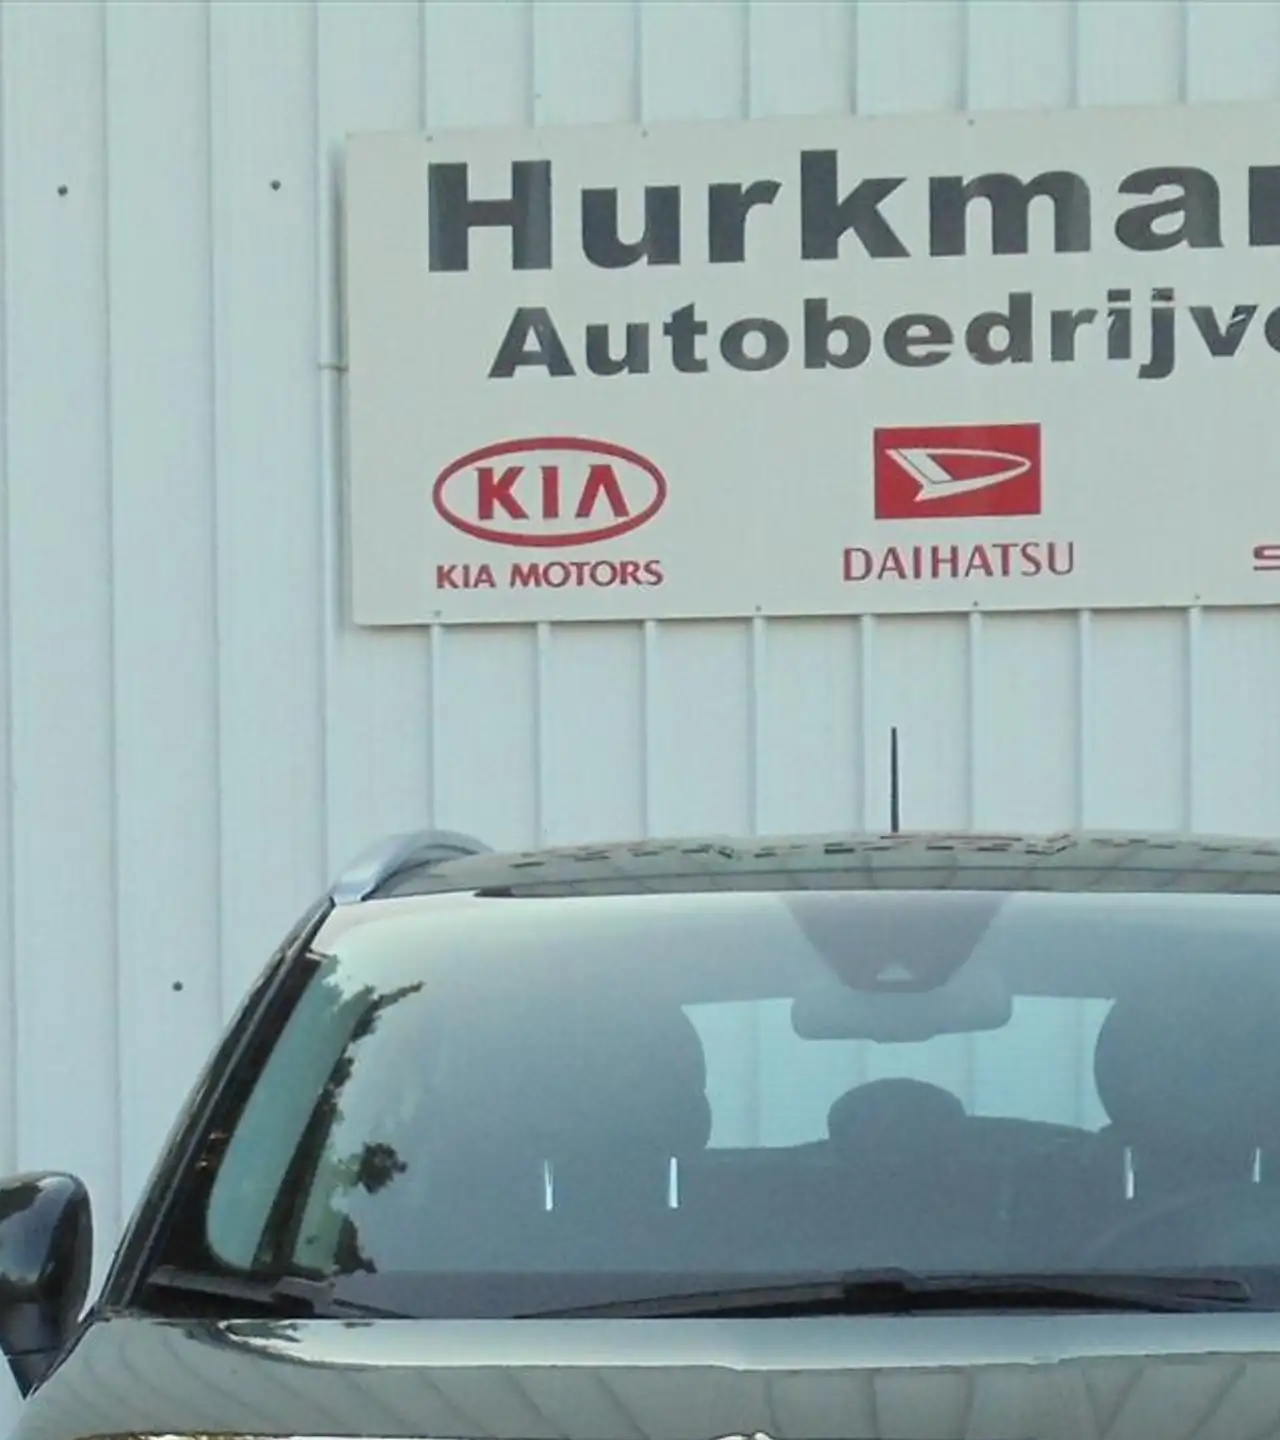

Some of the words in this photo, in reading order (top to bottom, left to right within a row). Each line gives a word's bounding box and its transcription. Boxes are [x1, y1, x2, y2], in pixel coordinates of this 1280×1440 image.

[475, 463, 630, 521] KIA
[436, 564, 497, 589] KIA
[510, 560, 664, 588] MOTORS
[842, 541, 1076, 582] DAIHATSU
